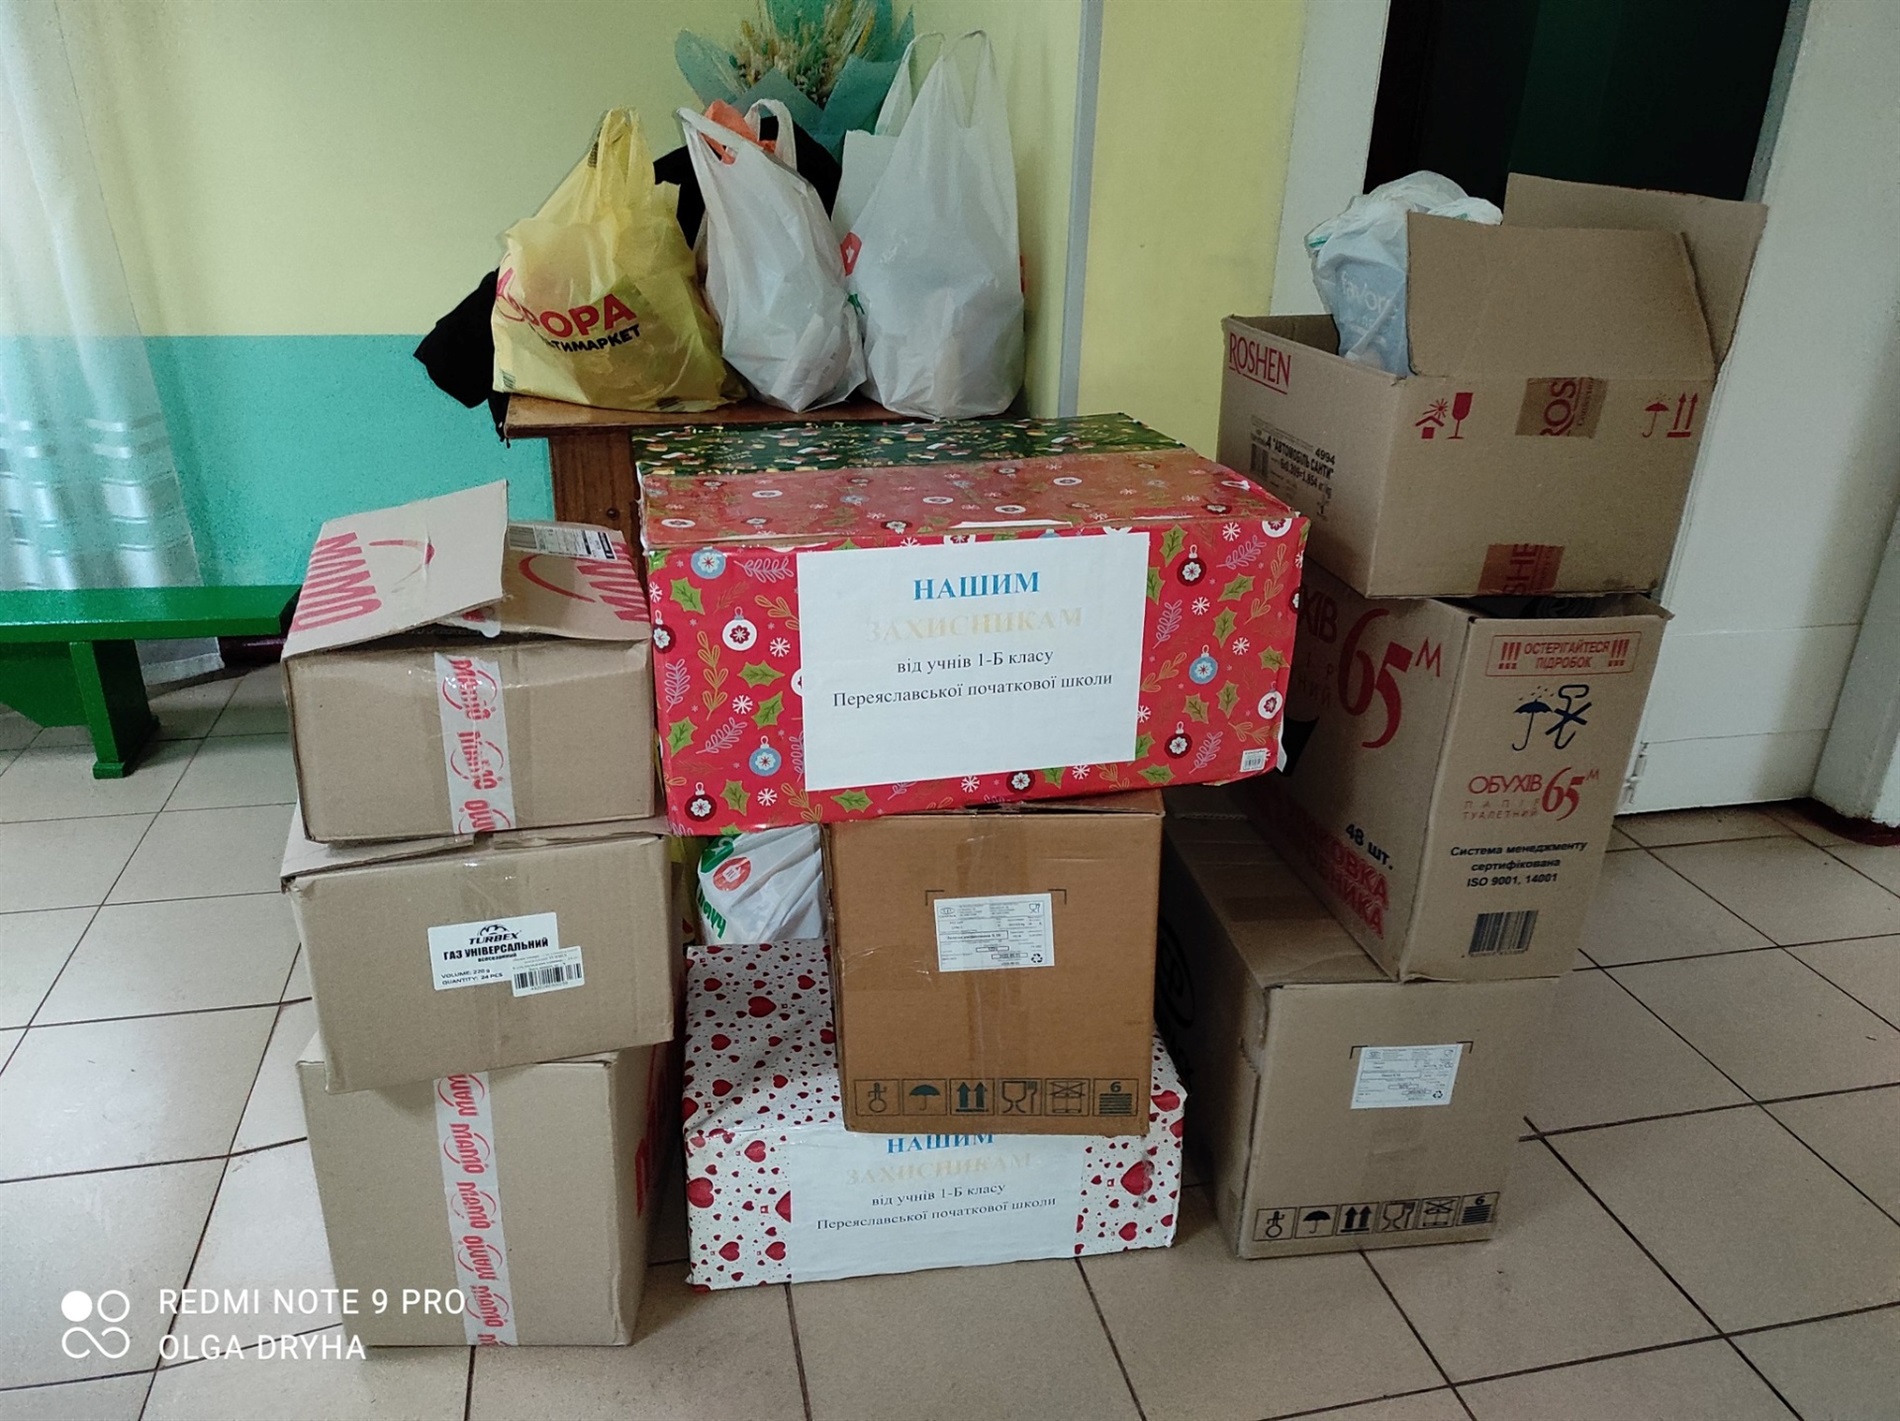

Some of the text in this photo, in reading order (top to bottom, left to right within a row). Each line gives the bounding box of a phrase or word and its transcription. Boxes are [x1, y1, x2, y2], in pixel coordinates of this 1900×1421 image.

[1229, 331, 1292, 388] ROSHEN
[1315, 448, 1336, 466] 4994
[913, 570, 1040, 600] НАШИМ
[865, 606, 1083, 642] ЗАХИСНИКАМ
[1523, 639, 1611, 655] ОСТЕРІГАЙТЕСЯ
[897, 650, 1054, 675] від учнів 1-Б класу
[1535, 656, 1593, 669] ПІДРОБОК
[833, 673, 1113, 709] Переяславської початкової школи
[1468, 773, 1542, 794] ОБУХІВ
[1345, 824, 1393, 870] 48 шт.
[1450, 841, 1589, 857] Система менеджменту
[1471, 859, 1561, 873] сертифікована
[1467, 877, 1489, 888] ISO
[1526, 873, 1558, 884] 14001
[443, 937, 549, 961] ГАЗ УНІВЕРСАЛЬНИЙ
[469, 932, 520, 945] TURBEX
[441, 971, 472, 979] VOLUME:
[442, 977, 478, 986] QUANTITY:
[1110, 1081, 1122, 1093] 6
[887, 1133, 995, 1154] НАШИМ
[845, 1153, 1031, 1186] ЗАХИСНИКАМ
[871, 1184, 1006, 1207] від учнів 1-Б класу
[1475, 1195, 1486, 1206] 6
[816, 1197, 1056, 1231] Переяславської початкової школи
